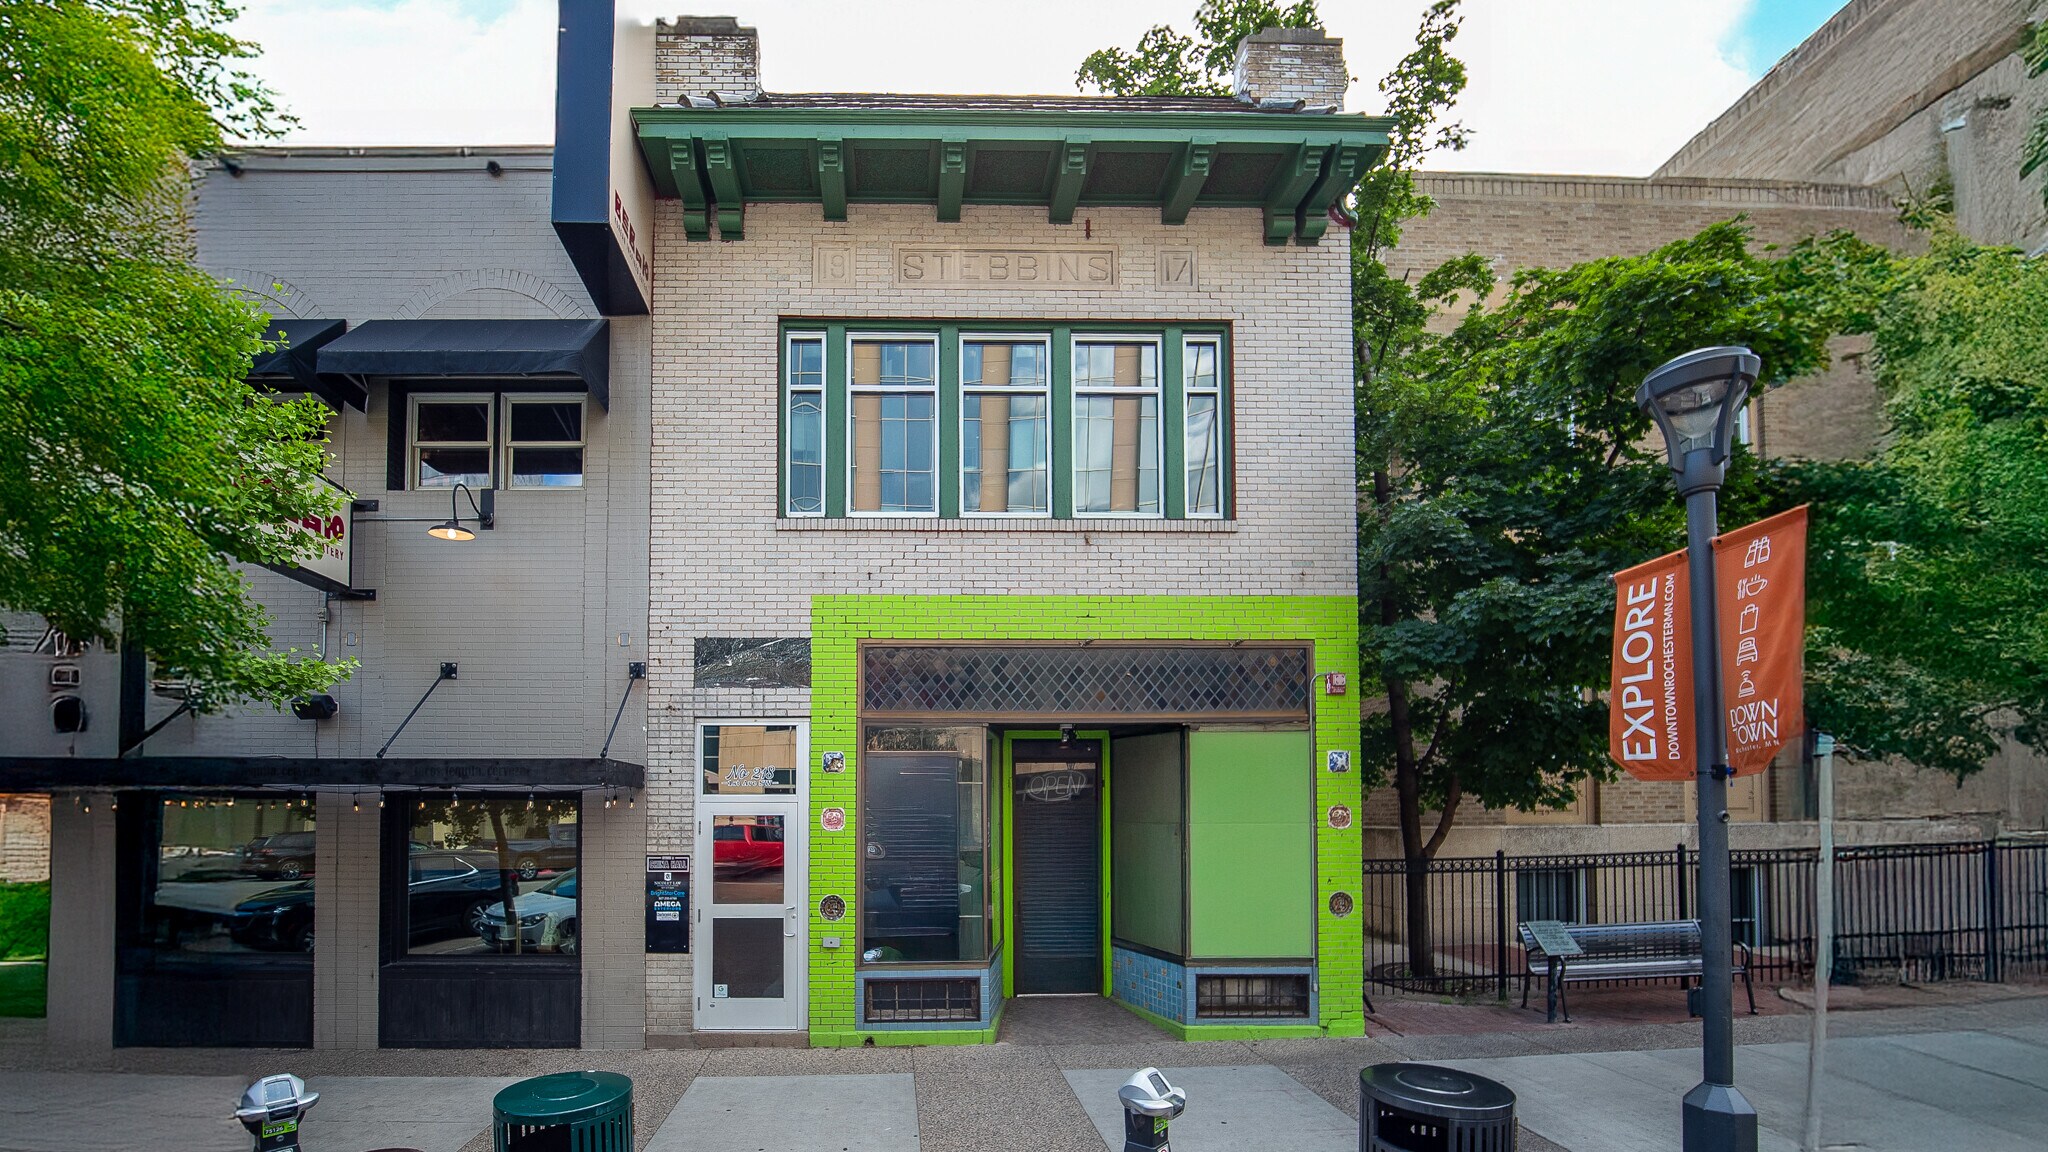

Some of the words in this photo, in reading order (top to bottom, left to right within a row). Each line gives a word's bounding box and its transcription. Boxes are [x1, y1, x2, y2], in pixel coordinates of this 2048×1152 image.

[822, 254, 845, 279] 19
[902, 254, 1110, 282] STEBBINS
[1164, 257, 1189, 282] 17
[1621, 576, 1657, 761] EXPLORE
[1661, 572, 1681, 760] DOWNTOWNROCHESTERMN.COM
[1730, 698, 1778, 728] DOWN
[1732, 719, 1778, 745] TOWN
[751, 765, 776, 780] 218
[1030, 775, 1081, 802] OPEN
